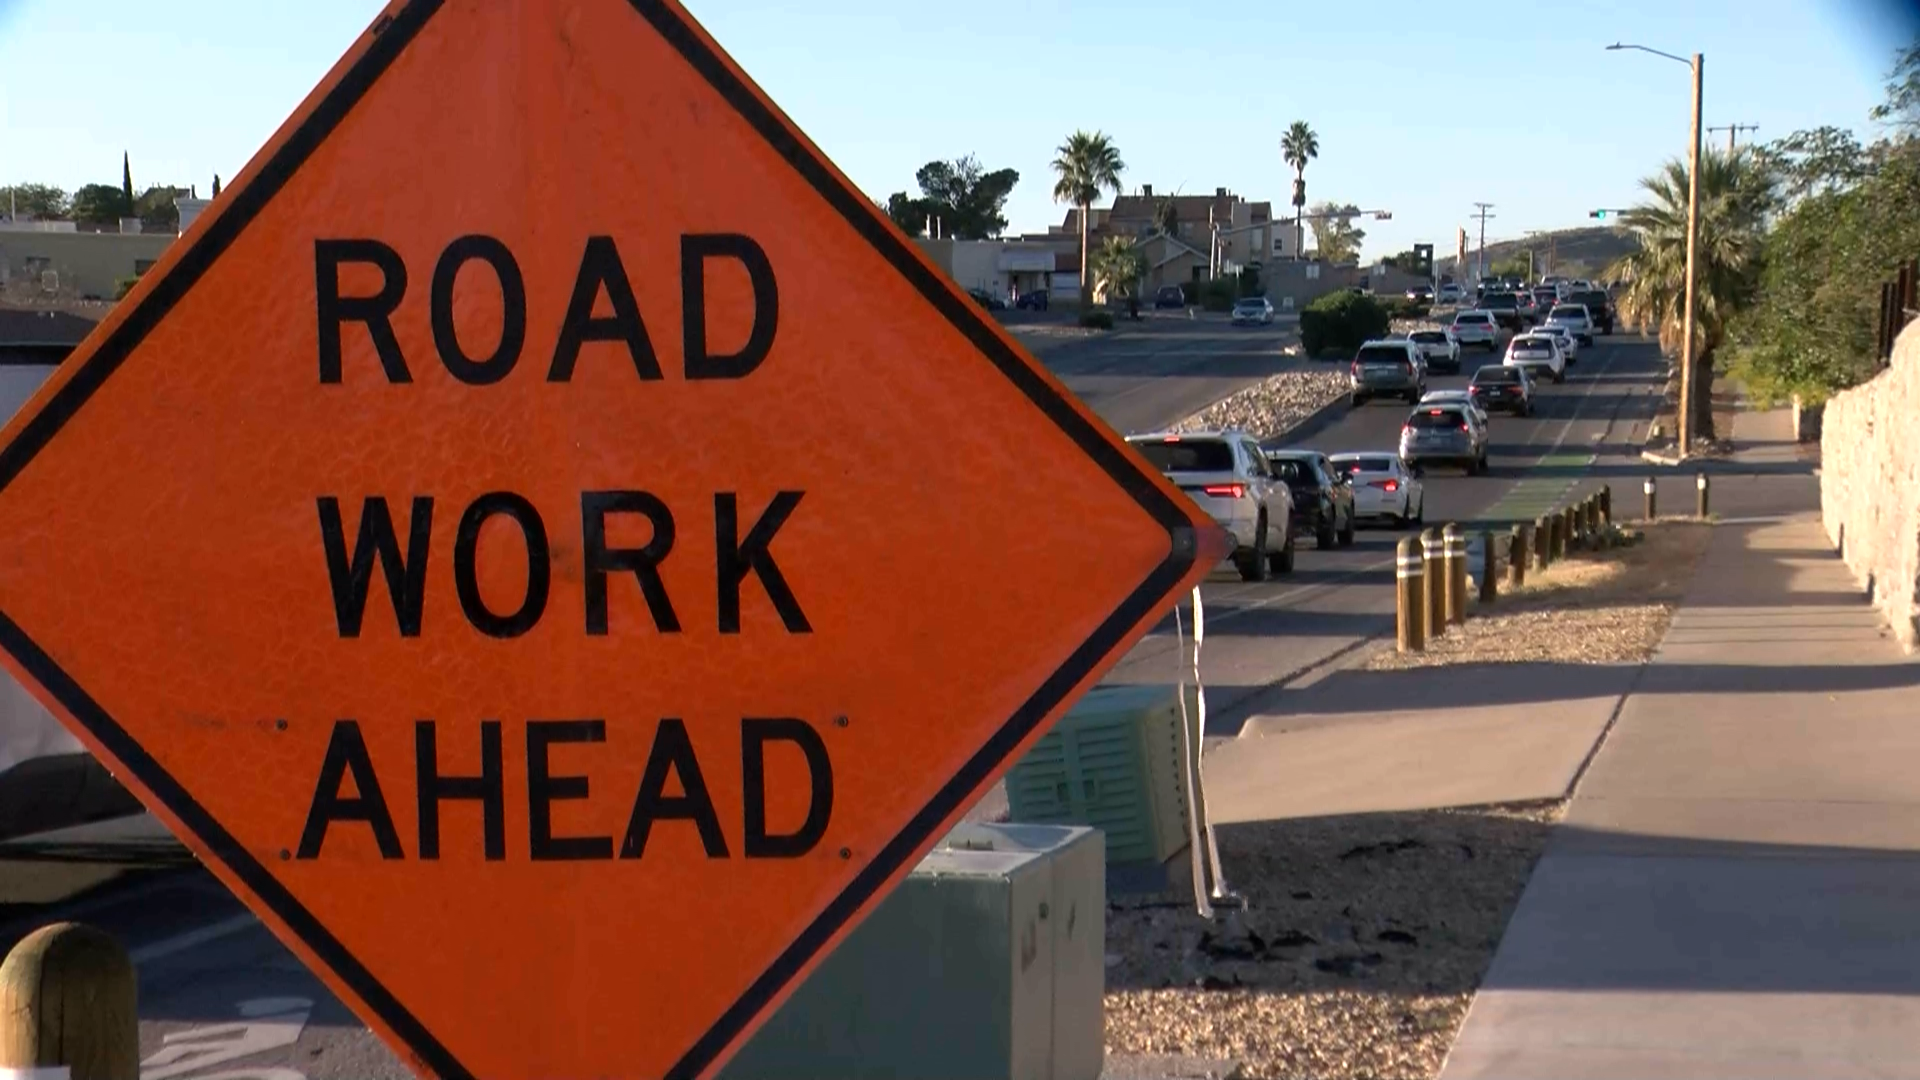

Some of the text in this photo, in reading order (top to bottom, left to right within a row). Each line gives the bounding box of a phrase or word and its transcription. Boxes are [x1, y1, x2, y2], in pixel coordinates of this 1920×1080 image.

[313, 231, 779, 386] ROAD
[316, 488, 813, 640] WORK
[295, 715, 834, 862] AHEAD
